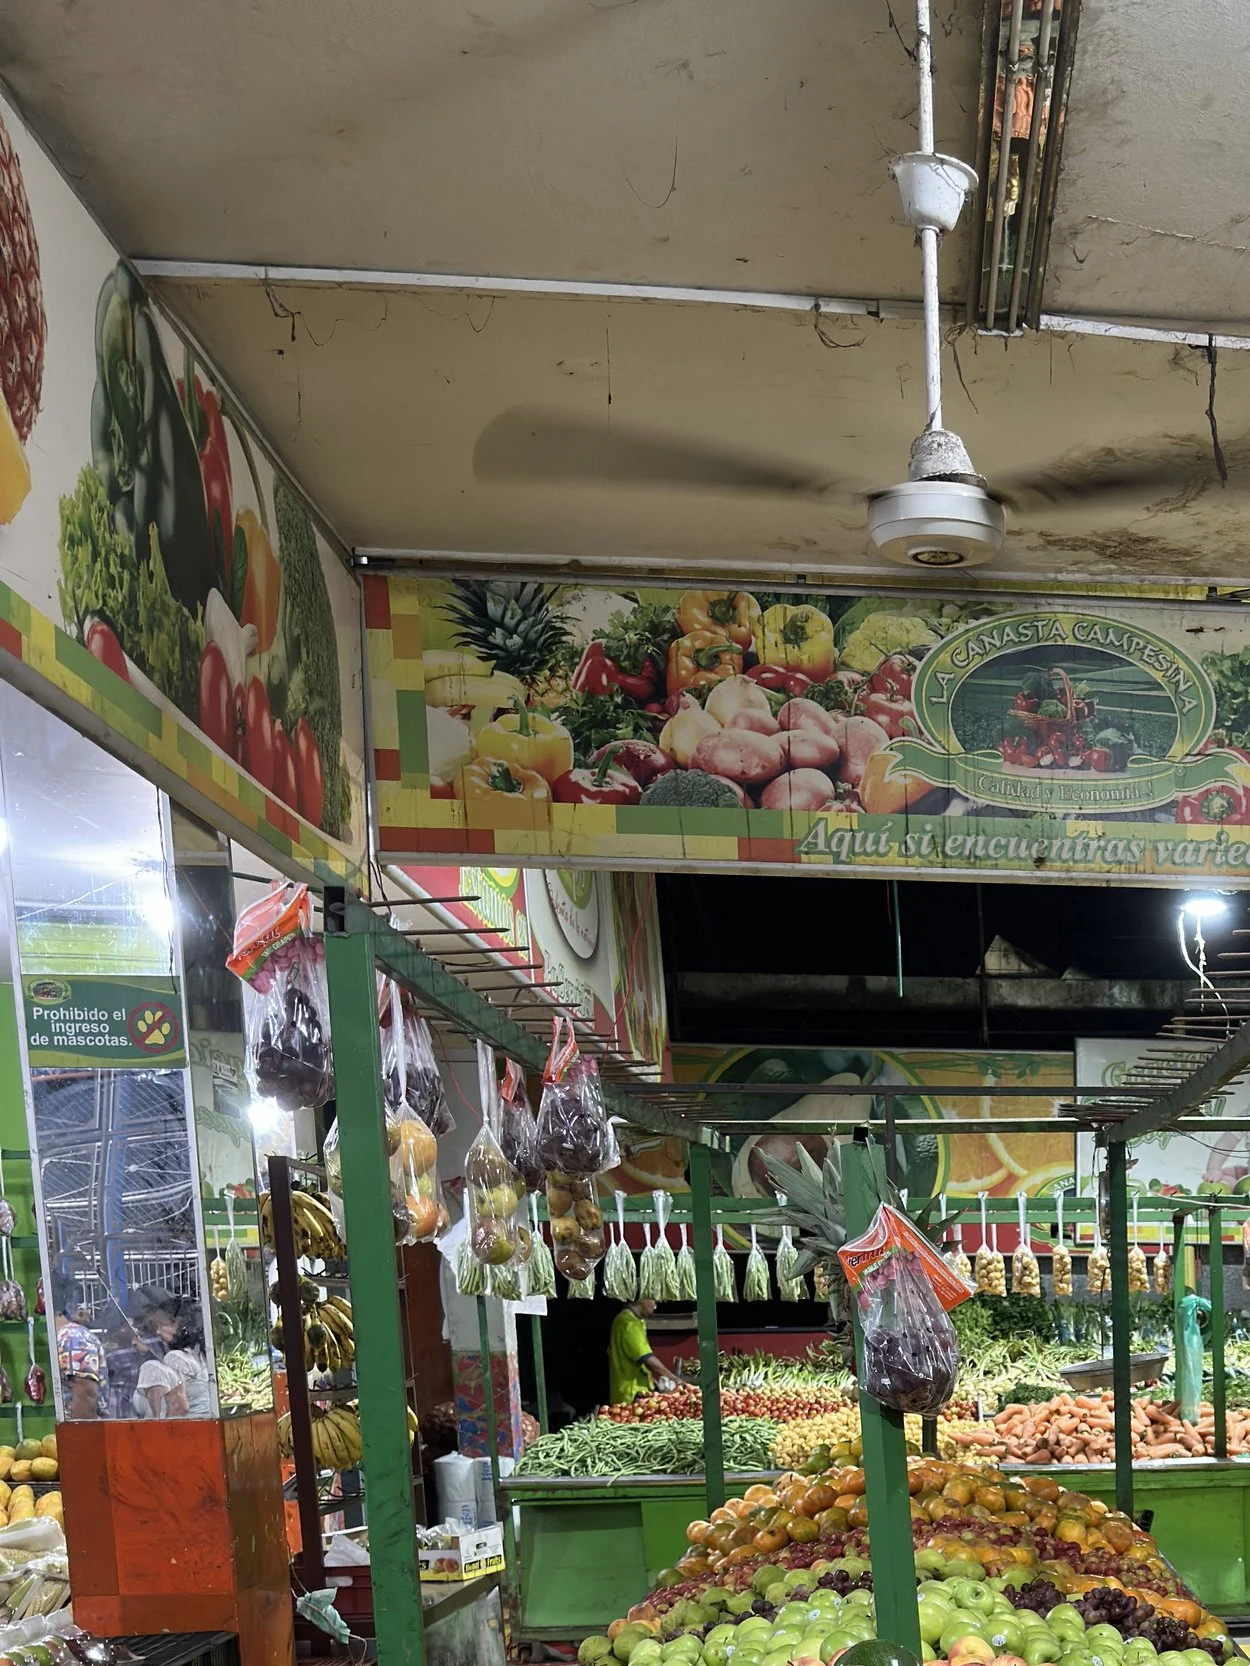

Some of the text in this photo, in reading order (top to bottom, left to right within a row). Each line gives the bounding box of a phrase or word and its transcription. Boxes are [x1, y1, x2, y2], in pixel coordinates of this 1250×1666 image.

[929, 619, 1199, 715] LA CANASTA CAMPESINA
[976, 775, 1041, 799] Calidad
[799, 818, 894, 862] Aquí
[900, 823, 936, 857] si
[944, 830, 1146, 865] encuentras
[32, 1007, 126, 1021] Prohibido el
[51, 1020, 110, 1036] ingreso
[30, 1033, 132, 1046] de mascotas.
